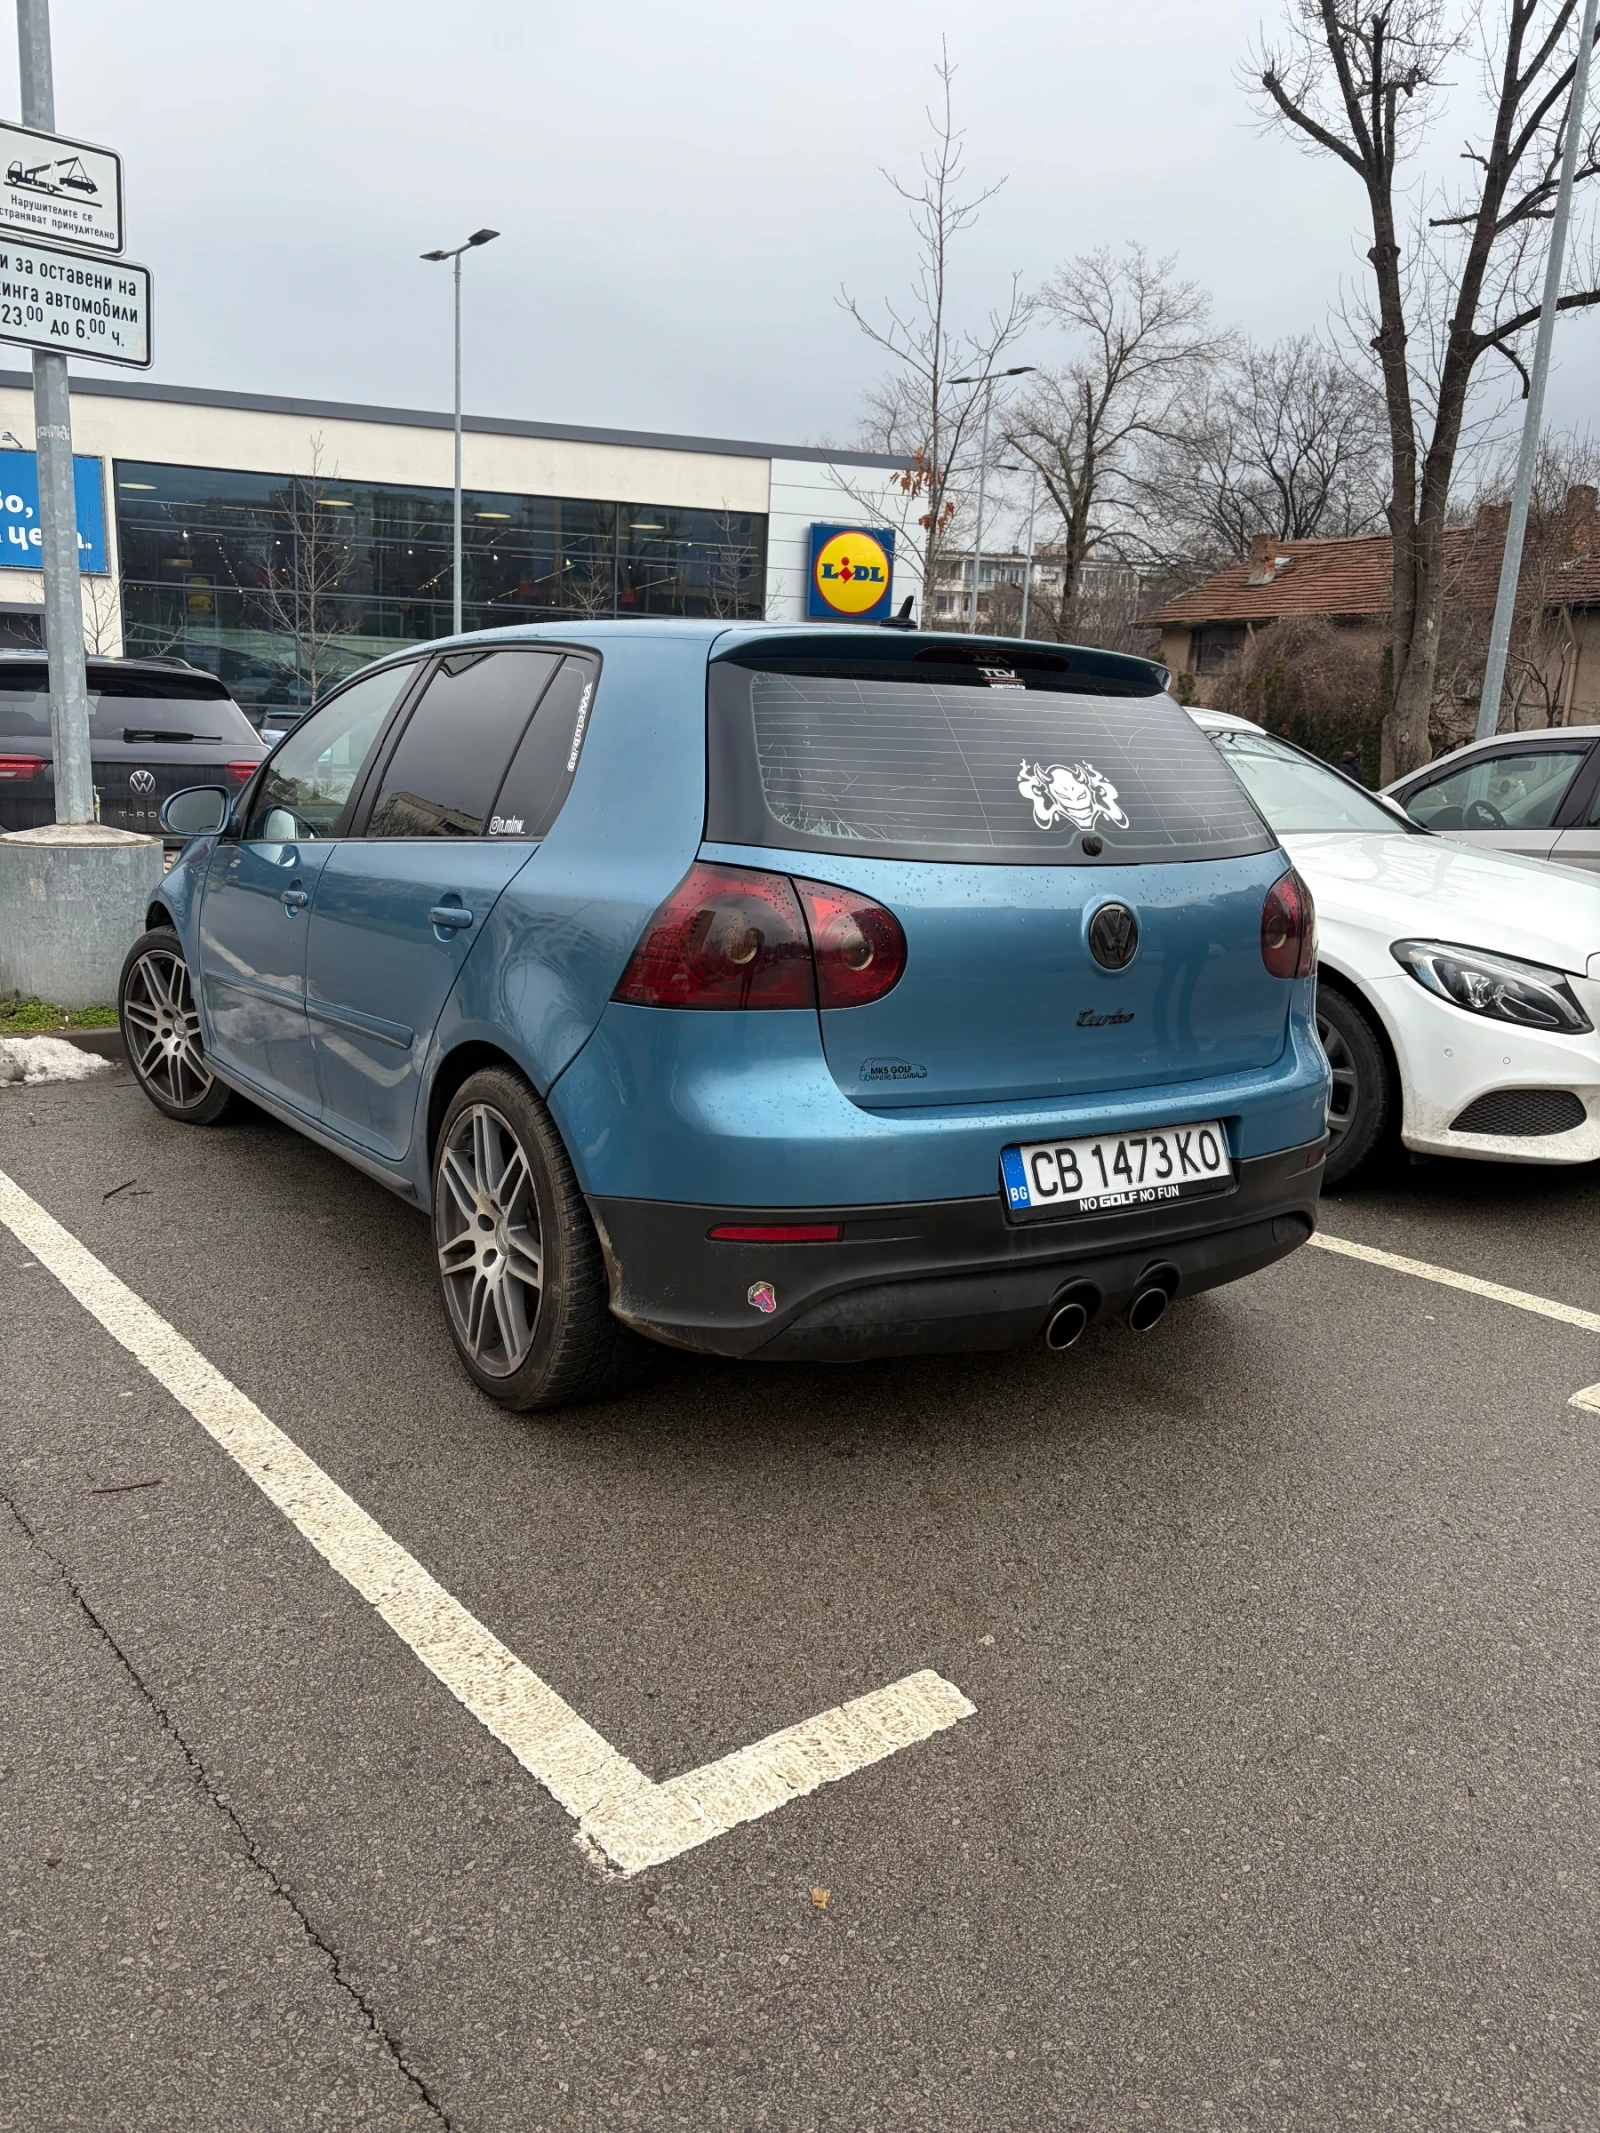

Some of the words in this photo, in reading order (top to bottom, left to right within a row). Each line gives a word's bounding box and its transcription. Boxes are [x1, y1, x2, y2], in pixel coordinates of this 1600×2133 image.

[11, 194, 78, 219] Нарушителите
[82, 213, 93, 222] се
[52, 219, 115, 240] принудително
[16, 258, 33, 275] за
[40, 263, 112, 291] оставени
[119, 280, 136, 296] на
[0, 281, 39, 303] инга
[45, 290, 138, 323] автомобили
[50, 319, 69, 336] до
[112, 331, 124, 347] ч.
[0, 490, 33, 518] о,
[118, 810, 157, 818] T-RO
[865, 1073, 892, 1081] OWNERS
[870, 1066, 889, 1075] MK5
[891, 1065, 912, 1074] GOLF
[1030, 1148, 1083, 1197] CB
[1091, 1136, 1173, 1188] 1473
[1174, 1129, 1220, 1176] KO
[1010, 1186, 1028, 1202] BG
[1079, 1198, 1097, 1211] NO
[1099, 1191, 1138, 1207] GOLF
[1139, 1188, 1156, 1202] NO
[1158, 1185, 1180, 1199] FUN
